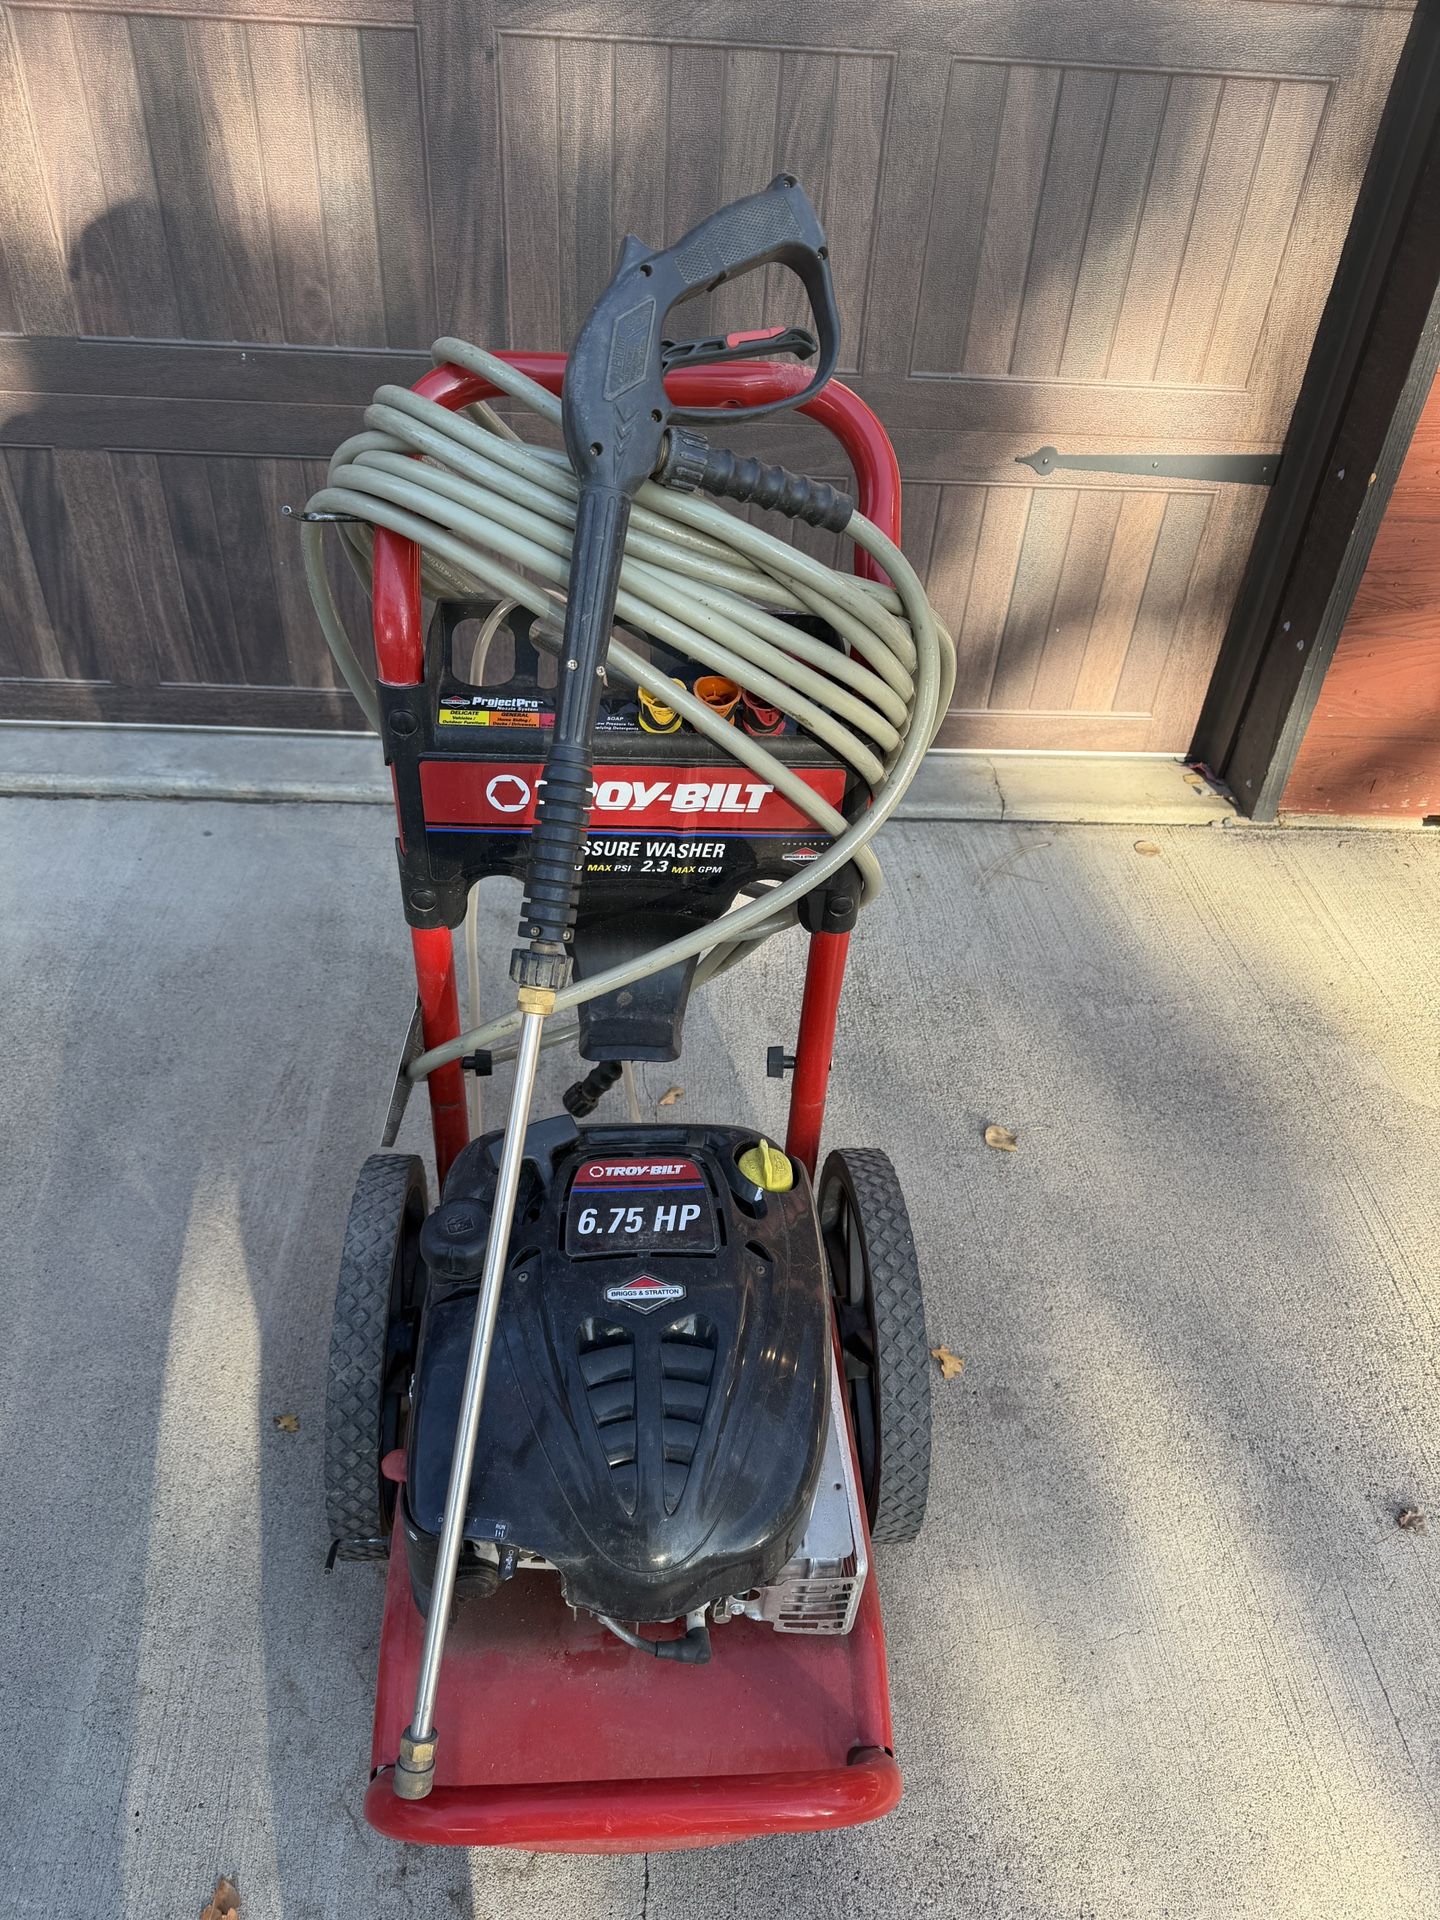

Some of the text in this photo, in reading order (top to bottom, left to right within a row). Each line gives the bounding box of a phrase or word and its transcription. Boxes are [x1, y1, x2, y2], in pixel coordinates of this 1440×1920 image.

[646, 842, 726, 859] WASHER
[614, 864, 632, 872] PSI
[640, 860, 723, 873] 2.3 MAX GPM
[605, 1164, 684, 1177] TROY-BILT
[577, 1204, 701, 1235] 6.75 HP
[644, 1288, 679, 1296] STRATTON
